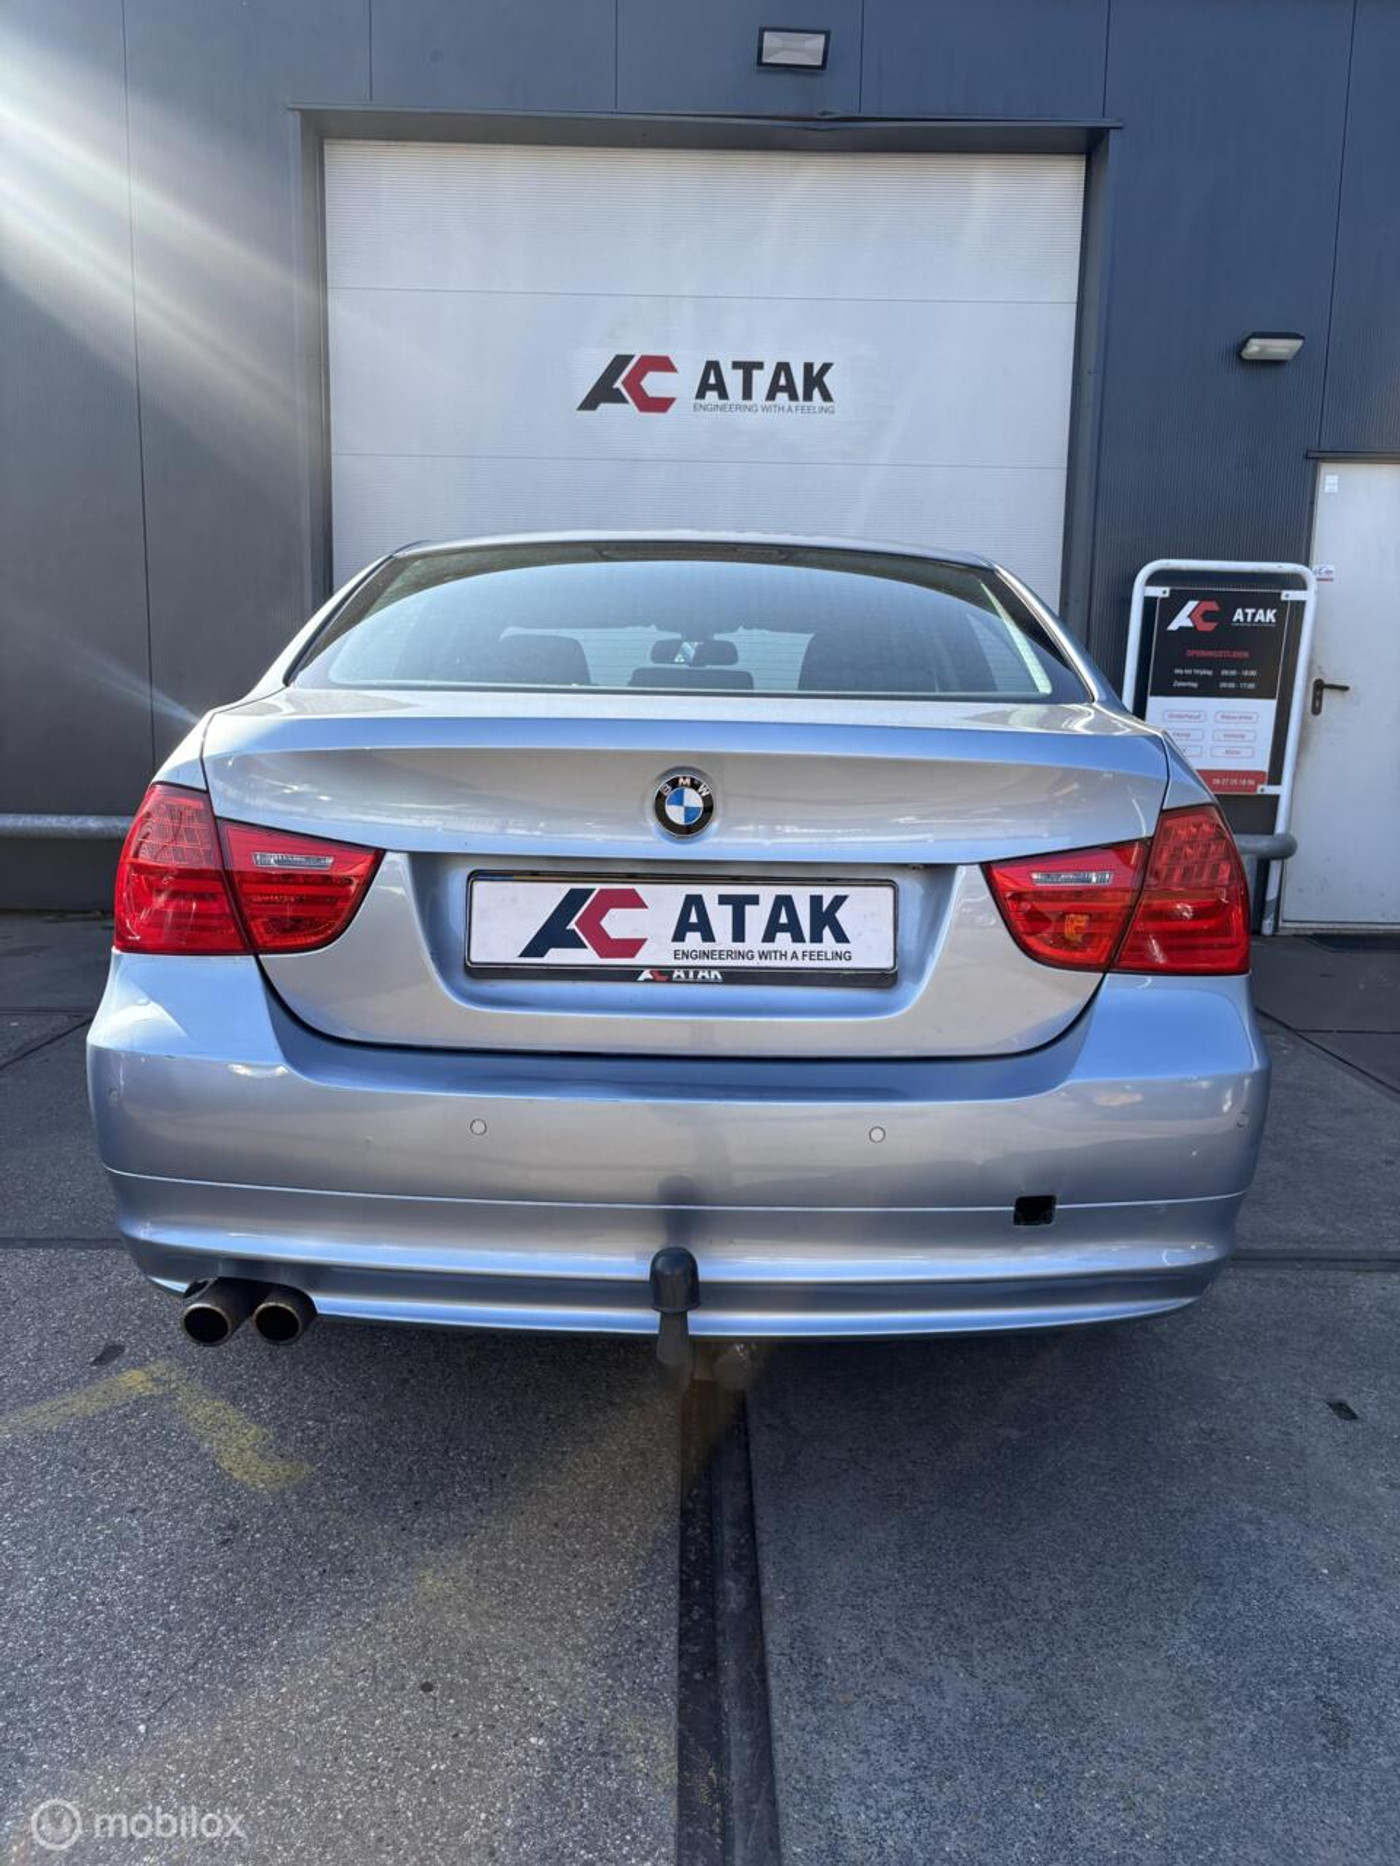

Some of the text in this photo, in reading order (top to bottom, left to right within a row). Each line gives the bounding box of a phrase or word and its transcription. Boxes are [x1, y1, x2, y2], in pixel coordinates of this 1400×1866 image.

[695, 360, 835, 402] ATAK
[693, 403, 835, 415] ENGINEERING WITH A FEELING
[1232, 608, 1277, 623] ATAK
[659, 776, 712, 797] BMW
[671, 893, 851, 944] ATAK
[673, 949, 852, 962] ENGINEERING WITH A FEELING
